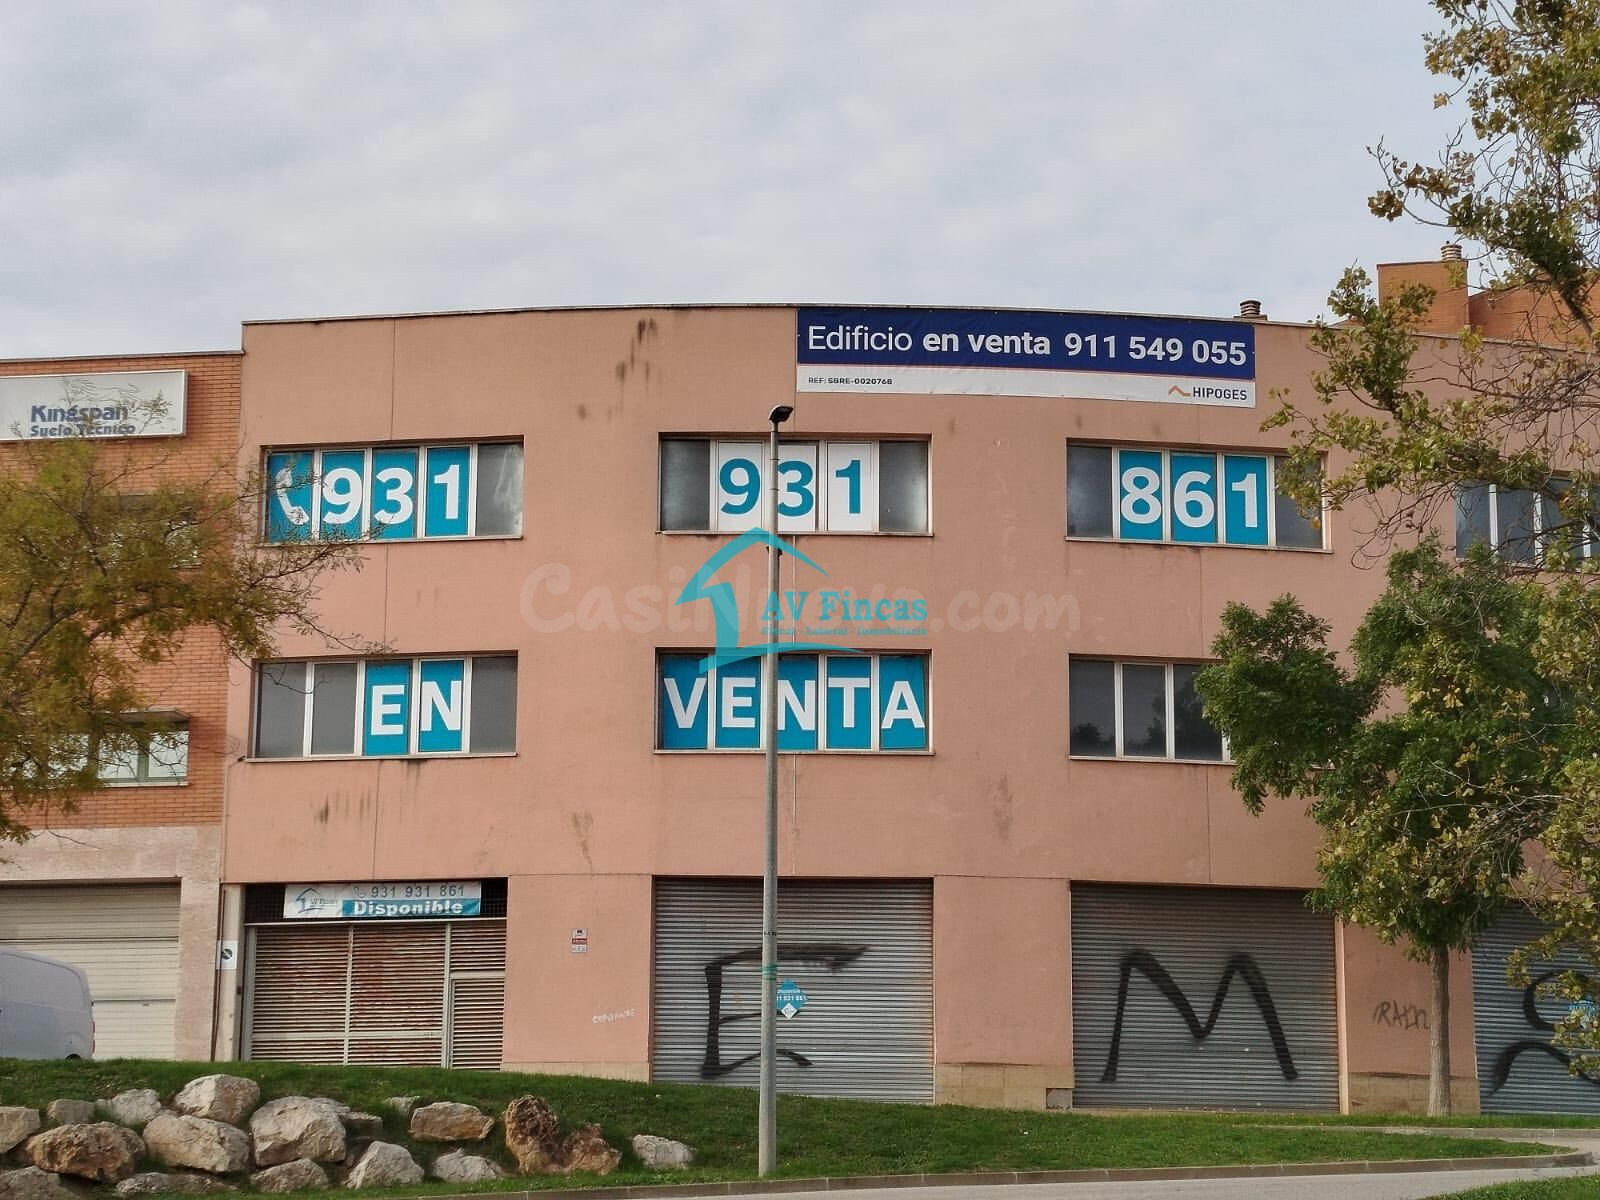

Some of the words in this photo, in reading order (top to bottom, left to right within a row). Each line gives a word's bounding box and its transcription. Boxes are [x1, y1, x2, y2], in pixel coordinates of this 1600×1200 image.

[808, 325, 912, 352] Edificio
[923, 331, 960, 353] en
[968, 330, 1051, 355] venta
[1064, 333, 1117, 358] 911
[1128, 336, 1183, 362] 549
[1192, 339, 1247, 366] 055
[1193, 386, 1248, 401] HIPOGES
[30, 404, 129, 423] Kingspan
[30, 424, 73, 437] Suelo
[322, 464, 460, 524] 931
[719, 458, 861, 517] 931
[1120, 466, 1258, 528] 861
[370, 680, 462, 736] EN
[664, 676, 925, 731] VENTA
[371, 886, 396, 898] 931
[405, 885, 430, 898] 931
[439, 884, 464, 897] 861
[354, 900, 464, 916] Disponible
